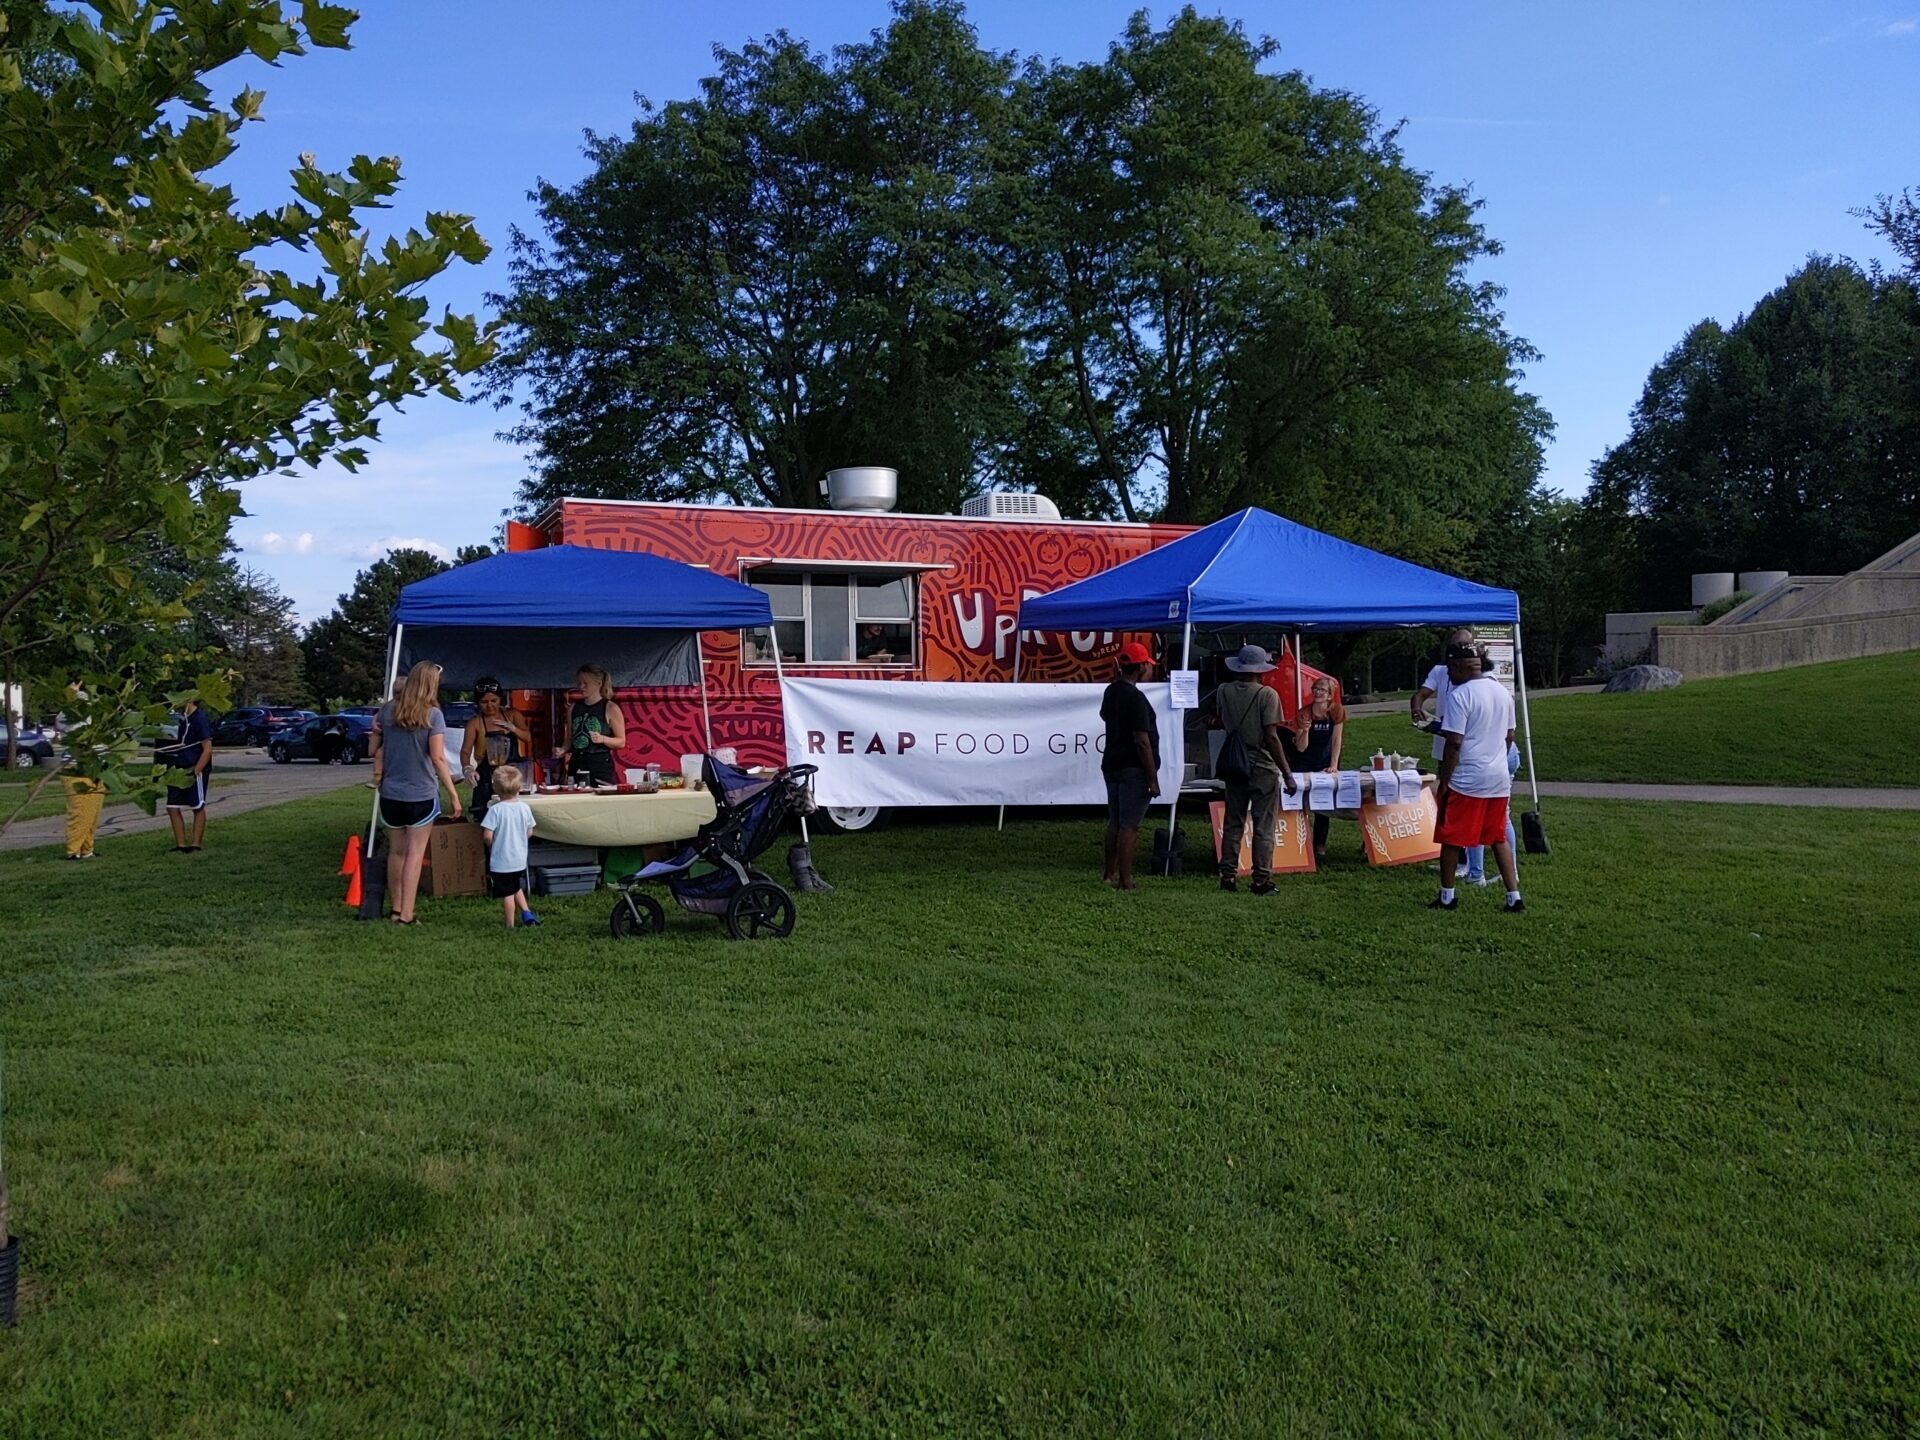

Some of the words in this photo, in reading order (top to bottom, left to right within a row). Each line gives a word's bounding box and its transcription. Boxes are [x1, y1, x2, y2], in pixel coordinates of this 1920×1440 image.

[713, 720, 783, 739] YUM!
[807, 731, 916, 755] REAP
[935, 733, 1029, 755] FOOD
[1048, 733, 1106, 755] GRO
[1377, 808, 1425, 828] PICK-UP
[1388, 822, 1422, 840] HERE
